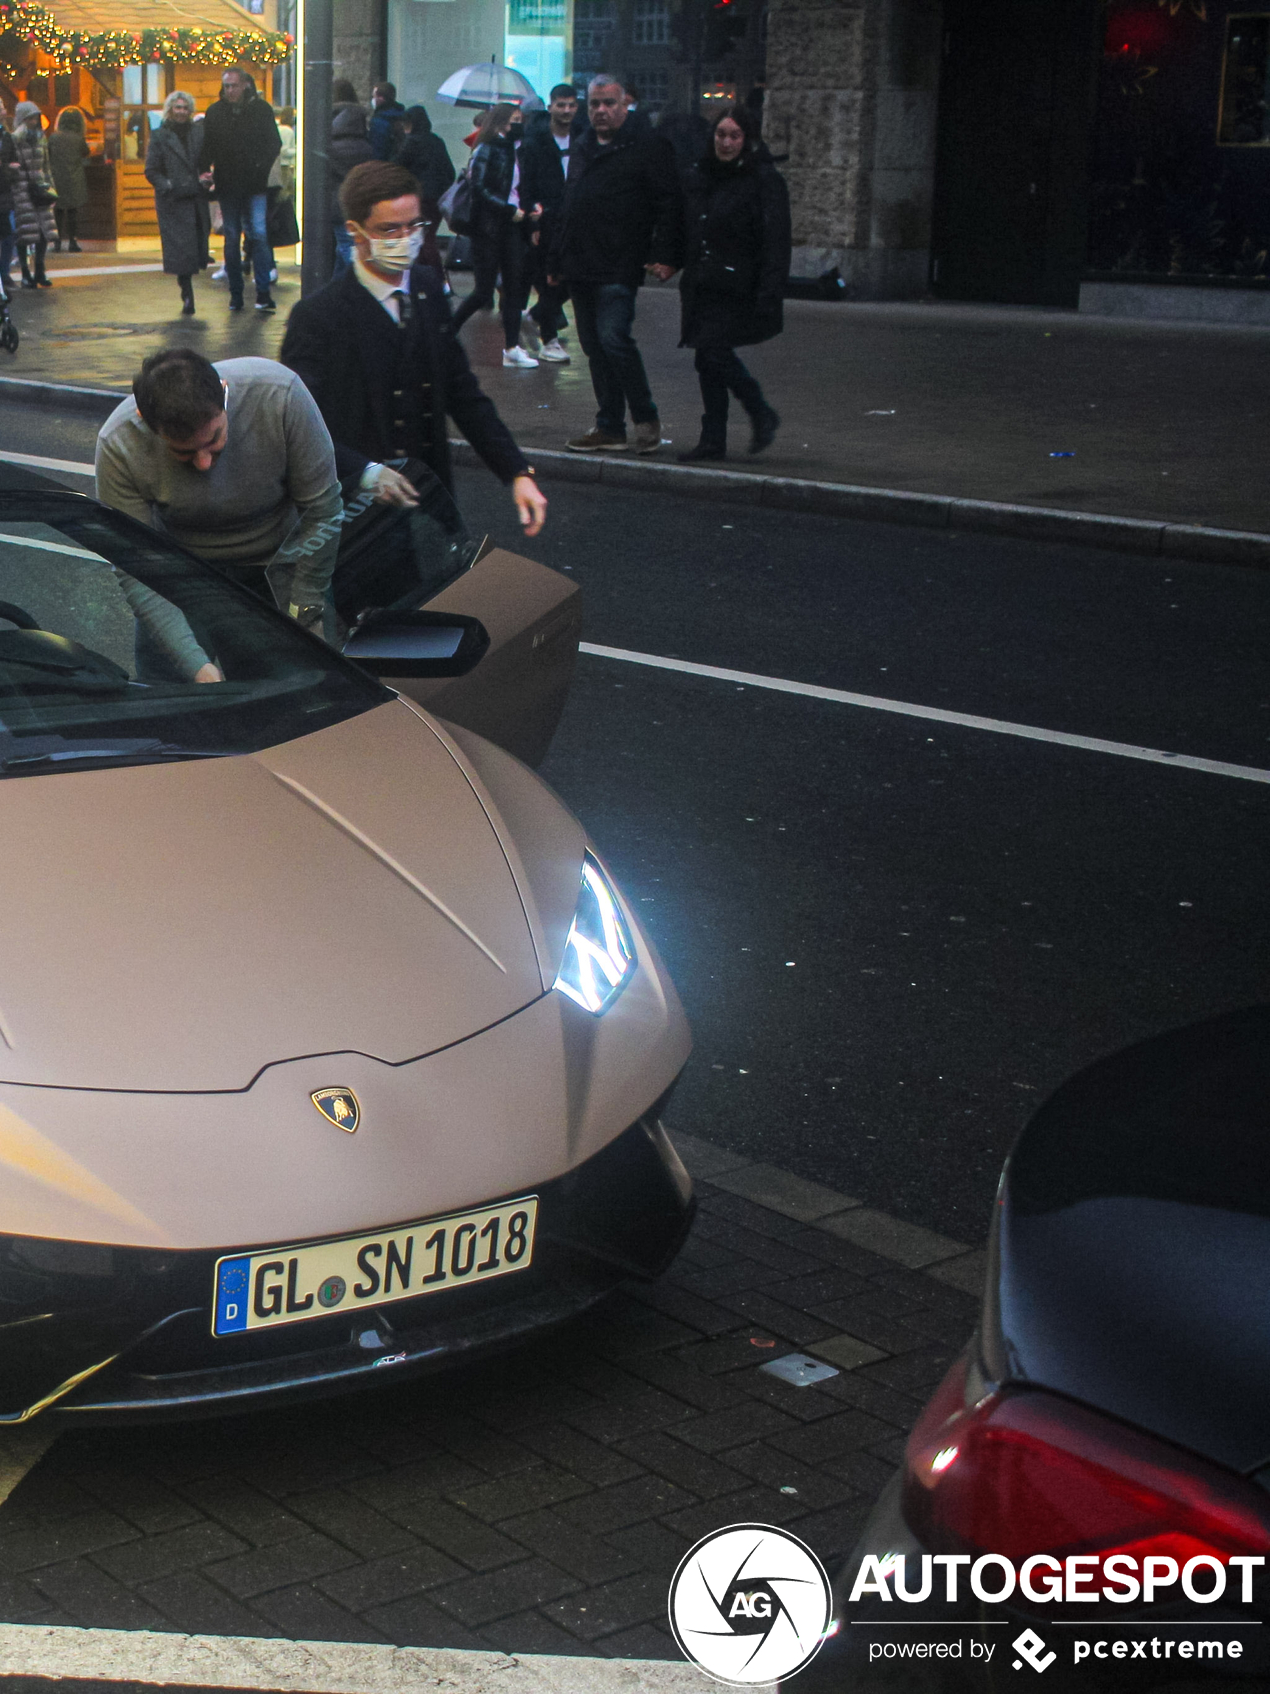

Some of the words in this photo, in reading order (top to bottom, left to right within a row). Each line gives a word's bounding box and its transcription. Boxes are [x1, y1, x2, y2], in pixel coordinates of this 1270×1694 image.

[253, 1257, 314, 1318] GL
[353, 1235, 414, 1298] SN
[422, 1210, 529, 1284] 1018
[226, 1303, 238, 1320] D
